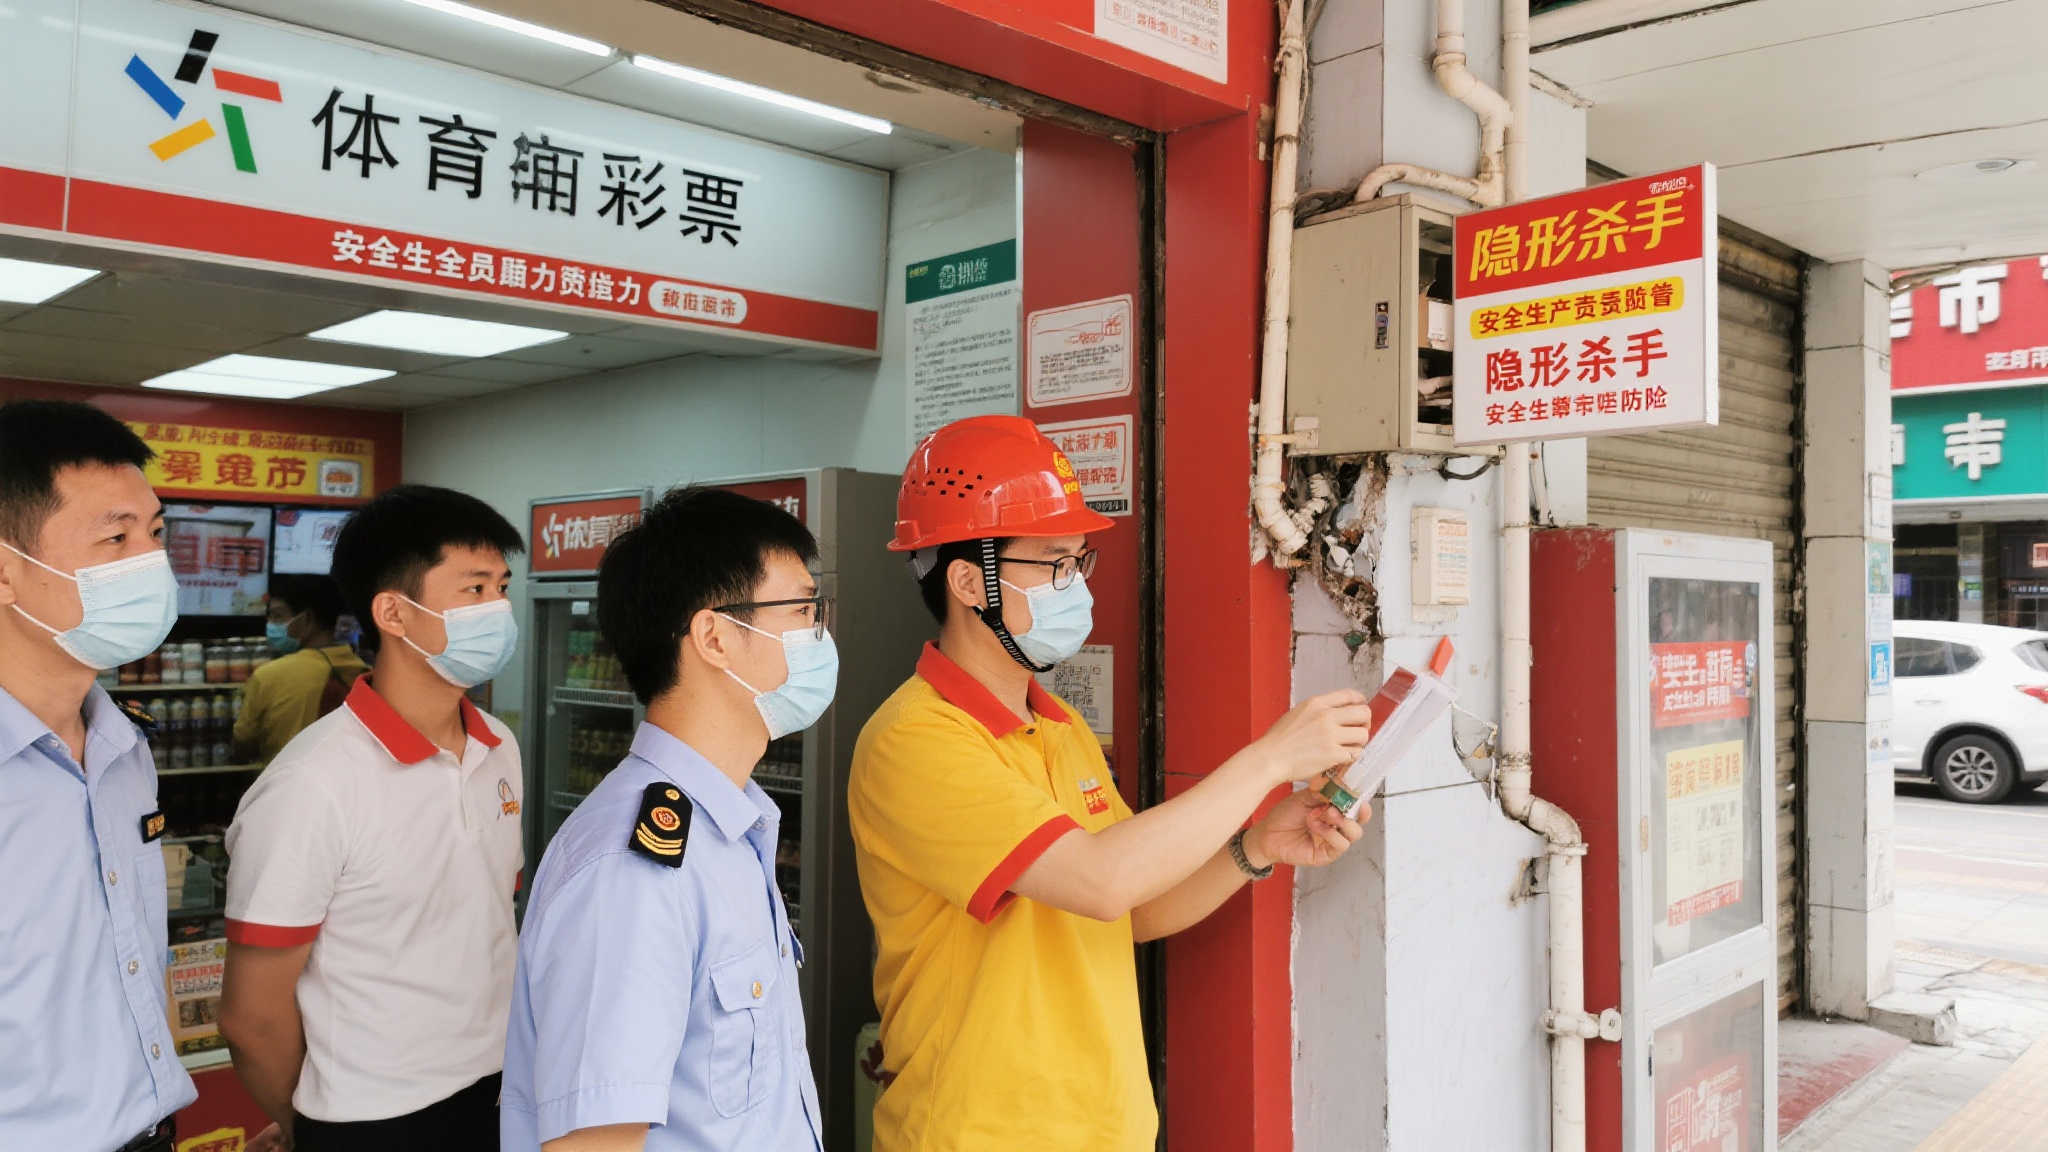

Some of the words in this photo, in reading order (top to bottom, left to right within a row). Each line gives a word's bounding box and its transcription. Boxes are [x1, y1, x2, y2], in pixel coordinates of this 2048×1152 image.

[1469, 191, 1686, 282] 隐形杀手
[1485, 328, 1668, 394] 隐形杀手
